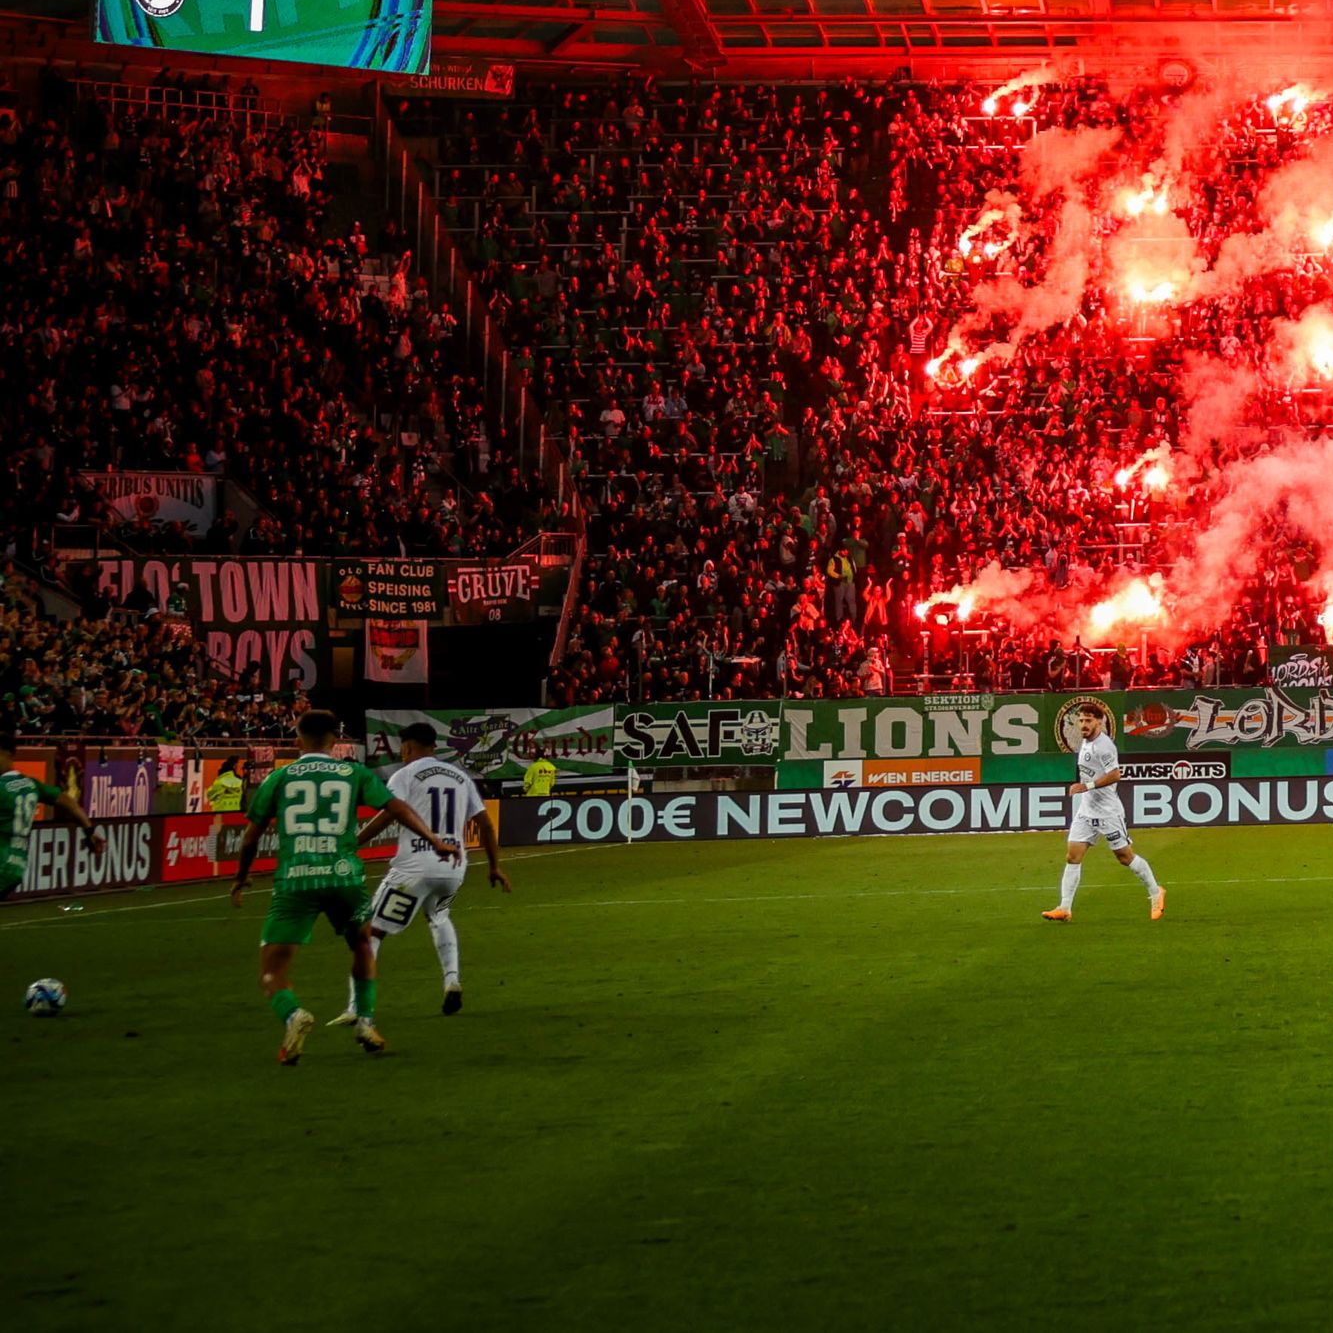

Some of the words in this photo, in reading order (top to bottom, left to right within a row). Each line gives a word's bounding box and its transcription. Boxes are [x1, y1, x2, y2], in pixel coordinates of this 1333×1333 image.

[409, 75, 485, 92] SCHURKEN
[155, 476, 204, 509] UNITIS
[367, 562, 396, 577] FAN
[399, 564, 435, 578] CLUB
[456, 564, 531, 604] GRÜVE
[191, 560, 320, 624] TOWN
[367, 580, 432, 598] SPEISING
[368, 598, 408, 615] SINCE
[411, 599, 438, 614] 1981
[207, 629, 318, 692] BOYS
[924, 695, 981, 706] SEKTION
[783, 703, 1040, 762] LIONS
[287, 762, 335, 777] spusu
[867, 771, 908, 785] WIEN
[911, 770, 974, 784] ENERGIE
[1119, 761, 1226, 780] EAMSPORTS
[90, 775, 132, 818] Allianz
[284, 779, 352, 836] 23
[427, 786, 455, 835] 11
[536, 795, 697, 841] 200€
[716, 785, 1083, 836] NEWCOME
[73, 821, 151, 890] BONUS
[293, 835, 338, 854] AUER
[287, 863, 332, 880] Allianz
[385, 892, 413, 922] E
